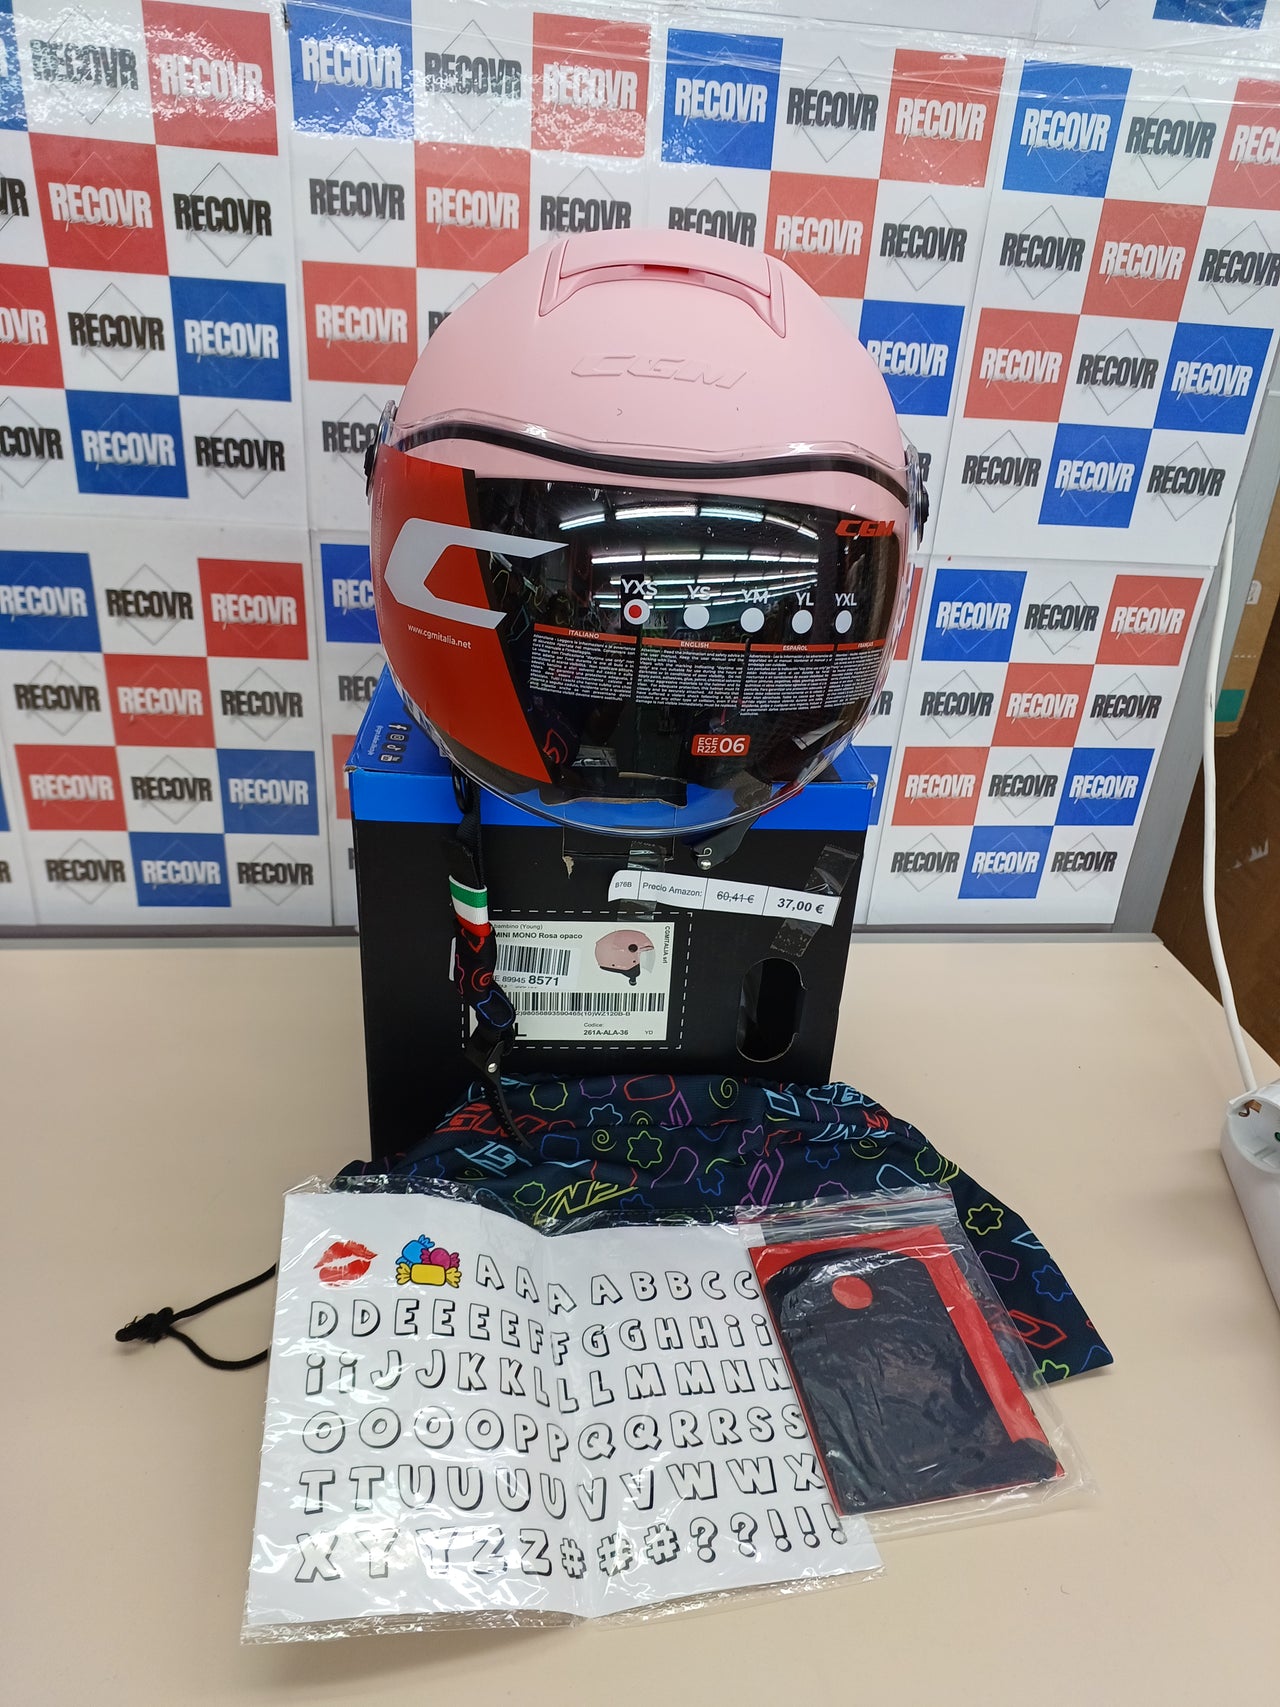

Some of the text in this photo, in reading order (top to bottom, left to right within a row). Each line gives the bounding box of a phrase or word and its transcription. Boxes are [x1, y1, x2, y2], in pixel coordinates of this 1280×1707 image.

[160, 54, 263, 103] RECOVR
[302, 40, 401, 89] RECOVR
[425, 52, 522, 99] RECOVR
[542, 62, 637, 110] RECOVR
[674, 77, 767, 123] RECOVR
[786, 87, 879, 131] RECOVR
[895, 97, 986, 141] RECOVR
[1020, 108, 1111, 152] RECOVR
[1125, 116, 1217, 159] RECOVR
[48, 182, 152, 229] RECOVR
[173, 193, 272, 236] RECOVR
[310, 178, 405, 221] RECOVR
[426, 186, 520, 230] RECOVR
[540, 194, 631, 233] RECOVR
[775, 214, 864, 256] RECOVR
[880, 222, 967, 263] RECOVR
[1000, 232, 1085, 272] RECOVR
[1099, 241, 1186, 280] RECOVR
[68, 312, 165, 351] RECOVR
[184, 319, 279, 359] RECOVR
[315, 304, 408, 343] RECOVR
[979, 347, 1063, 384] RECOVR
[1076, 354, 1159, 389] RECOVR
[1170, 361, 1254, 397] RECOVR
[82, 430, 176, 467] RECOVR
[195, 436, 285, 471] RECOVR
[961, 454, 1041, 487] RECOVR
[1054, 459, 1136, 493] RECOVR
[1147, 465, 1226, 497] RECOVR
[835, 520, 896, 537] CGM
[105, 589, 194, 620] RECOVR
[211, 592, 297, 625] RECOVR
[621, 579, 658, 596] YXS
[687, 585, 711, 600] YS
[796, 592, 814, 606] YL
[835, 593, 857, 607] YXL
[935, 601, 1012, 630] RECOVR
[1024, 603, 1099, 632] RECOVR
[1110, 607, 1185, 634] RECOVR
[407, 622, 472, 650] www.cgmitalia.net
[568, 629, 600, 639] ITALIANO
[680, 640, 709, 648] ENGLISH
[14, 684, 101, 712] RECOVR
[117, 686, 204, 716] RECOVR
[220, 689, 303, 718] RECOVR
[920, 691, 994, 717] RECOVR
[1005, 692, 1079, 718] RECOVR
[1090, 694, 1162, 719] RECOVR
[697, 737, 718, 745] ECE
[697, 745, 717, 753] R22
[719, 737, 745, 753] 06
[29, 774, 114, 801] RECOVR
[131, 776, 212, 802] RECOVR
[228, 778, 309, 806] RECOVR
[904, 774, 976, 799] RECOVR
[988, 775, 1058, 798] RECOVR
[1068, 775, 1139, 799] RECOVR
[45, 858, 126, 883] RECOVR
[141, 859, 221, 885] RECOVR
[237, 862, 314, 886] RECOVR
[890, 851, 960, 873] RECOVR
[971, 851, 1040, 874] RECOVR
[1050, 851, 1117, 873] RECOVR
[642, 881, 703, 897] Precio Amazon:
[777, 898, 825, 914] 37,00 €
[502, 975, 560, 986] 89945 8571
[476, 1254, 759, 1315] A A A A B B C C
[309, 1301, 338, 1339] D
[352, 1299, 380, 1337] D
[394, 1299, 419, 1335] E
[432, 1299, 455, 1336] E
[469, 1303, 490, 1340] E
[500, 1309, 520, 1347] E
[528, 1319, 544, 1354] F
[551, 1332, 569, 1365] F
[582, 1324, 610, 1357] G
[619, 1319, 647, 1351] G
[655, 1317, 683, 1350] H
[689, 1316, 718, 1348] H
[370, 1350, 402, 1390] J
[416, 1349, 446, 1388] J
[457, 1352, 487, 1391] K
[500, 1357, 526, 1396] K
[534, 1366, 550, 1407] L
[557, 1378, 579, 1414] L
[589, 1370, 614, 1407] L
[625, 1362, 666, 1399] M
[675, 1360, 715, 1395] M
[720, 1360, 755, 1393] N
[514, 1414, 538, 1453] P
[547, 1423, 569, 1462] P
[578, 1422, 616, 1460] Q
[624, 1414, 662, 1450] Q
[670, 1410, 703, 1448] R
[708, 1408, 742, 1445] R
[747, 1407, 774, 1442] S
[299, 1456, 777, 1521] T T U U U U V V W W
[519, 1506, 820, 1579] Z # # ? ! !
